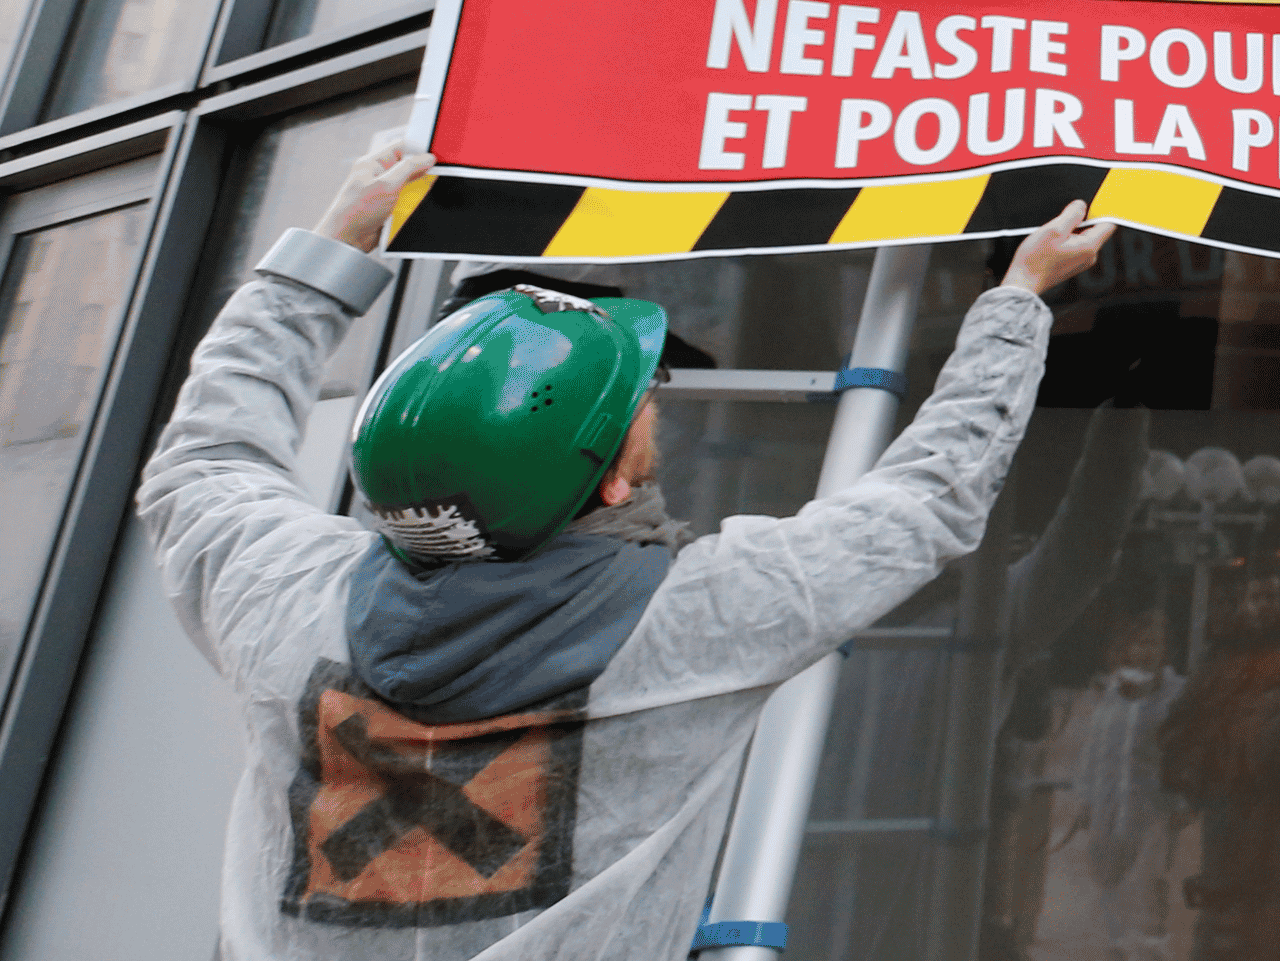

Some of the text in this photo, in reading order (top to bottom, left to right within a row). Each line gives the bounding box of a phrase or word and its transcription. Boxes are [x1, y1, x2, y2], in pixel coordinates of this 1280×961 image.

[698, 92, 808, 170] ET
[834, 88, 1085, 169] POUR
[1114, 98, 1207, 161] LA
